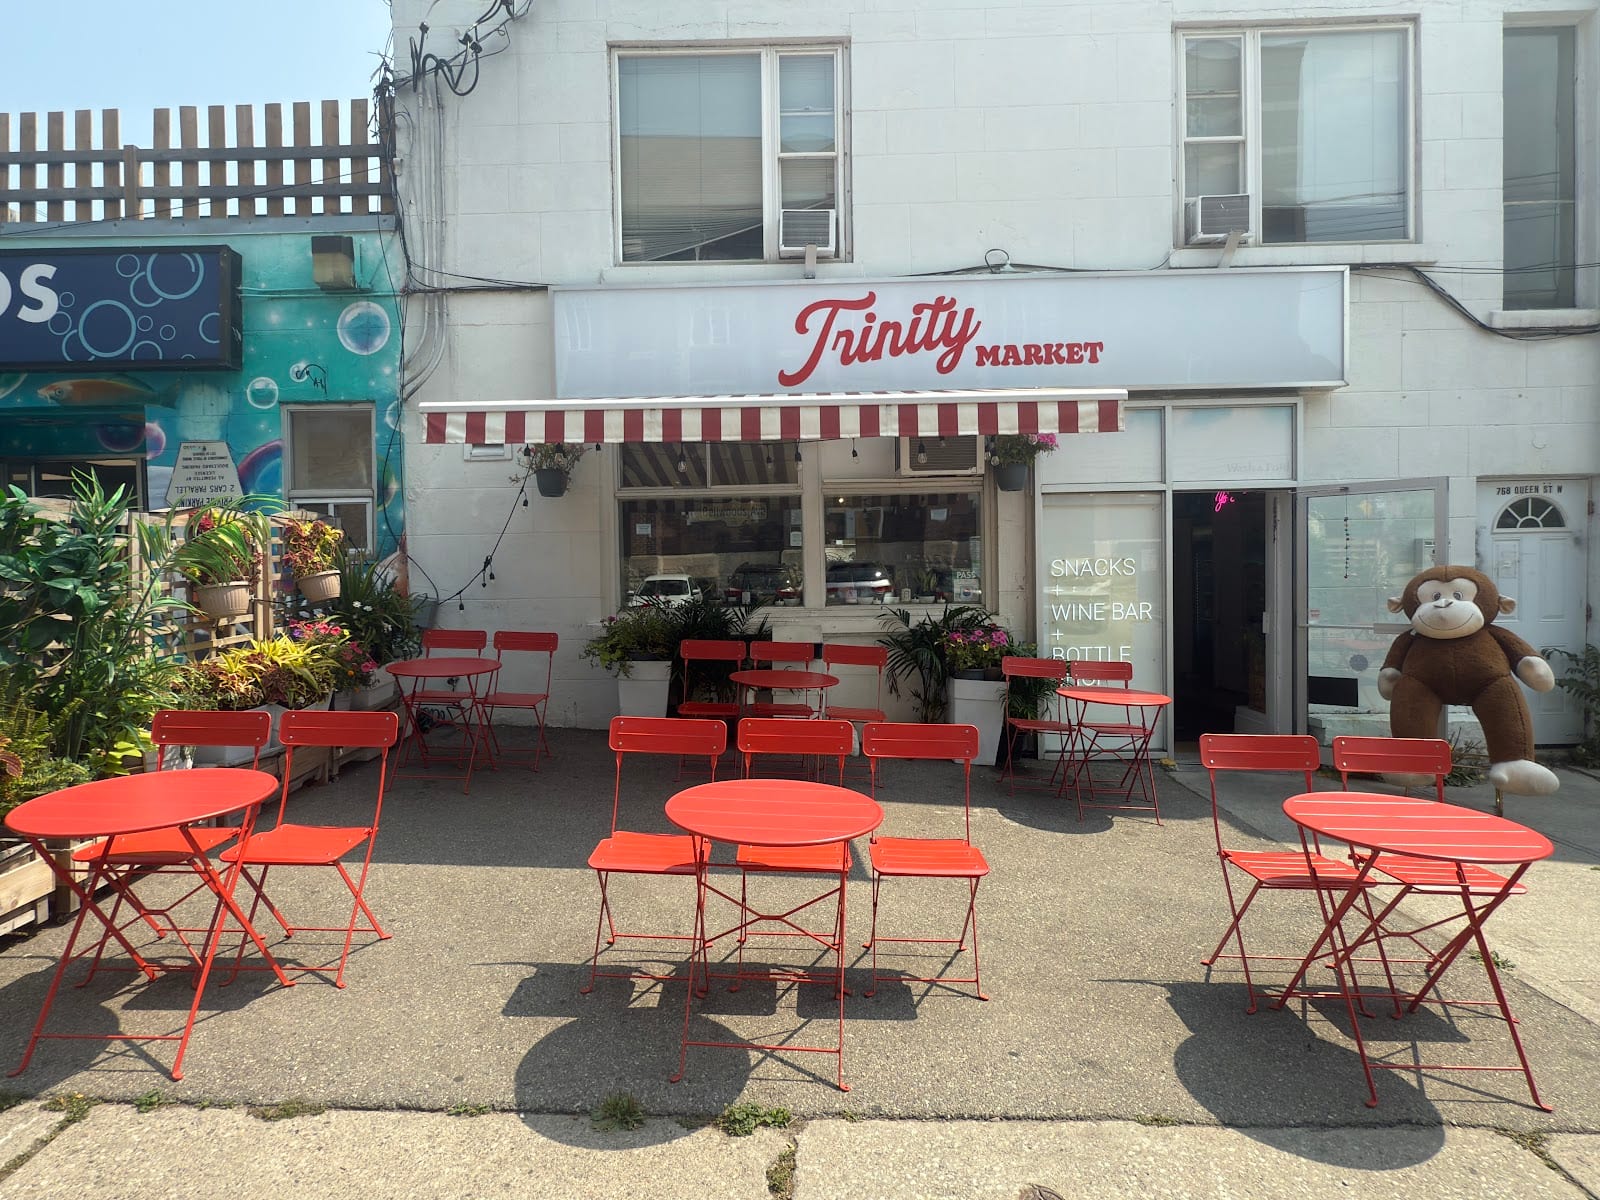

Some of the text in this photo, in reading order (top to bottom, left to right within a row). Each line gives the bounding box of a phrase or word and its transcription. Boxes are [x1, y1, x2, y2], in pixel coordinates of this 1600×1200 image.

[0, 263, 59, 323] S
[778, 291, 1104, 387] Trinity MARKET
[175, 484, 235, 494] 2 CARS PARALLEL
[1514, 485, 1539, 495] QUEEN
[1543, 485, 1552, 494] ST
[956, 571, 976, 579] PASS
[1050, 558, 1136, 577] SNACKS
[1051, 602, 1153, 621] WINE BAR
[1052, 646, 1132, 663] BOTTLE
